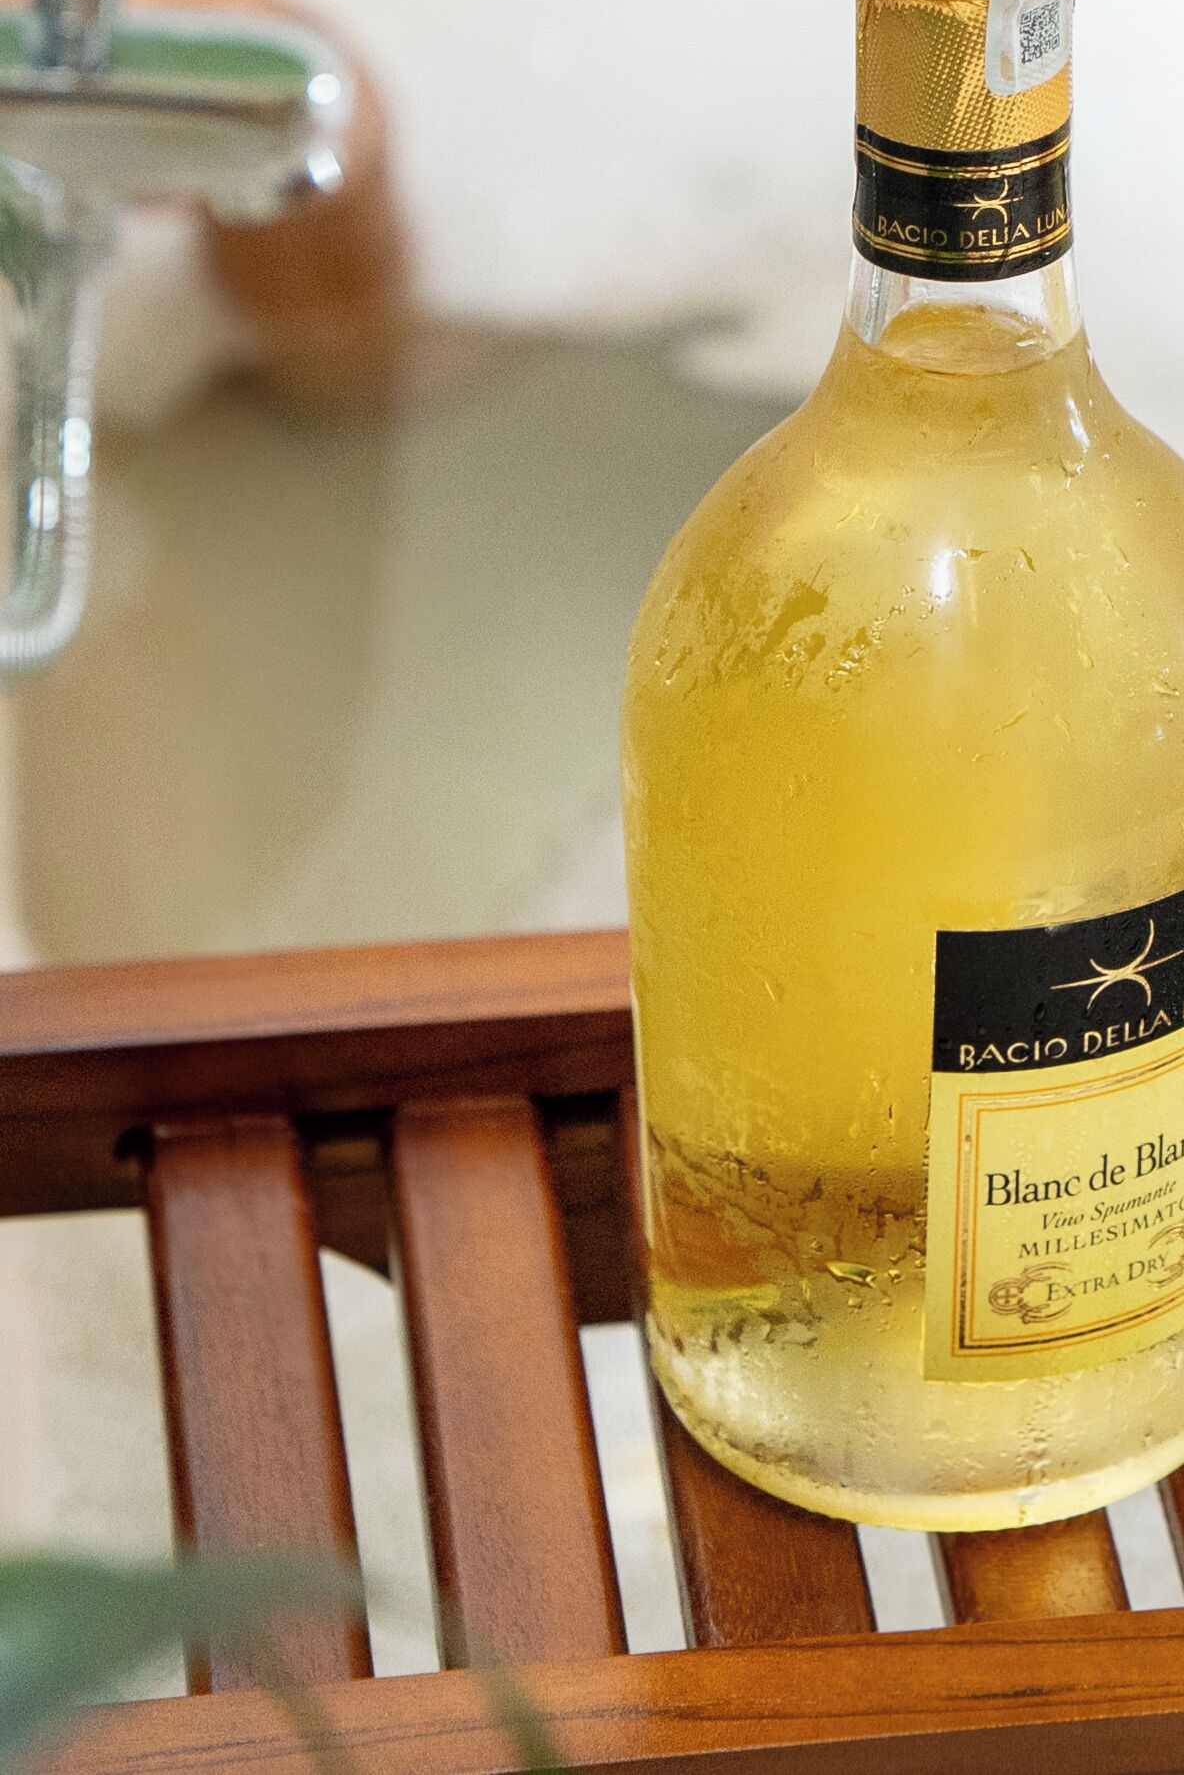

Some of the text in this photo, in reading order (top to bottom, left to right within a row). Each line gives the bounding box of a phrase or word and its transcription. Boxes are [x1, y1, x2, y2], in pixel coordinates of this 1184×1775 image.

[878, 215, 948, 247] BACIO
[959, 1037, 1068, 1071] BACIO
[1083, 1008, 1172, 1055] DELLA
[984, 1169, 1081, 1207] Blanc
[1088, 1153, 1126, 1192] de
[1041, 1179, 1177, 1231] Vino Spumante
[1046, 1272, 1120, 1302] EXTRA
